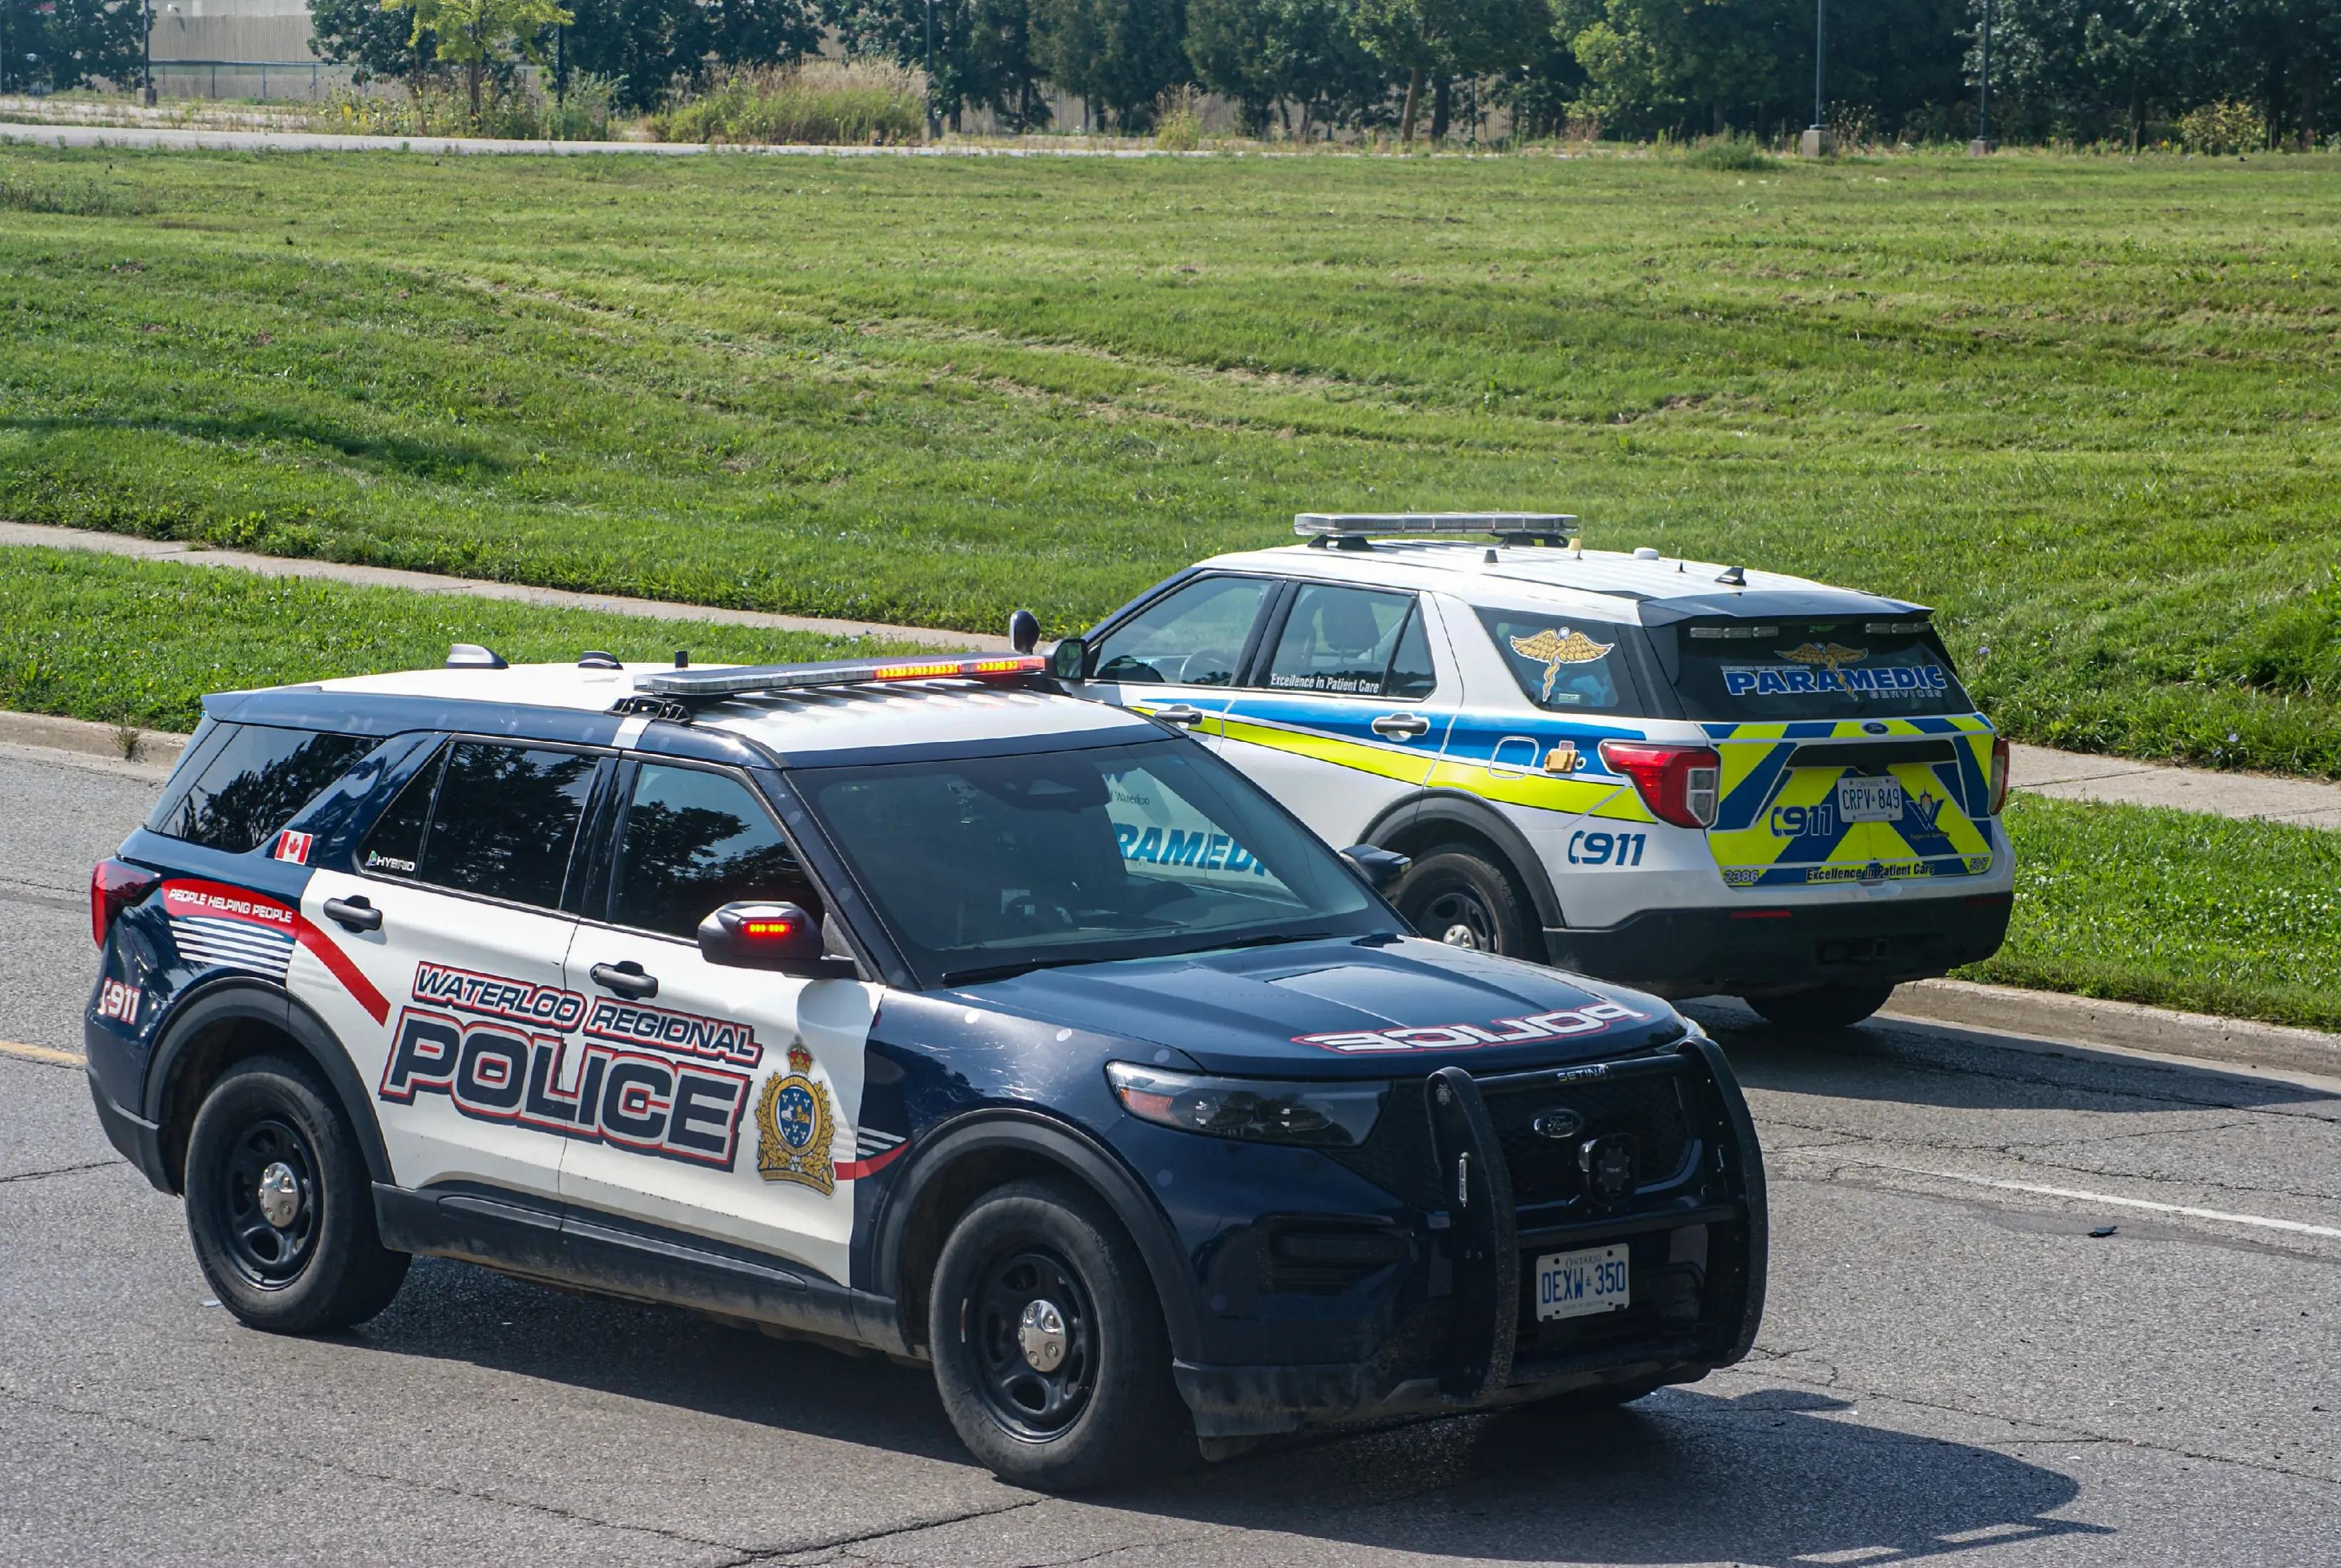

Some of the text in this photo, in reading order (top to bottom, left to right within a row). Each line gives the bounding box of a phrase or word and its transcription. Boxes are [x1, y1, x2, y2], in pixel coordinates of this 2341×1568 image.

[1270, 674, 1379, 693] Excellence in Patient Care
[1723, 664, 1948, 696] PARAMEDIC
[1869, 689, 1943, 699] SERVICES
[1842, 788, 1900, 810] CRPV 849
[1782, 804, 1833, 837] 911
[1581, 832, 1647, 867] 911
[376, 855, 416, 872] HYBRID
[1724, 869, 1759, 884] 2386
[1806, 862, 1935, 881] Excellence in Patient Care
[168, 888, 294, 924] PEOPLE HELPING PEOPLE
[106, 981, 142, 1026] 911
[412, 960, 764, 1068] WATERLOO REGIONAL
[1557, 1067, 1607, 1082] SETINA
[379, 1005, 752, 1173] POLICE
[1565, 1254, 1602, 1269] ONTARIO
[1595, 1261, 1625, 1296] 350
